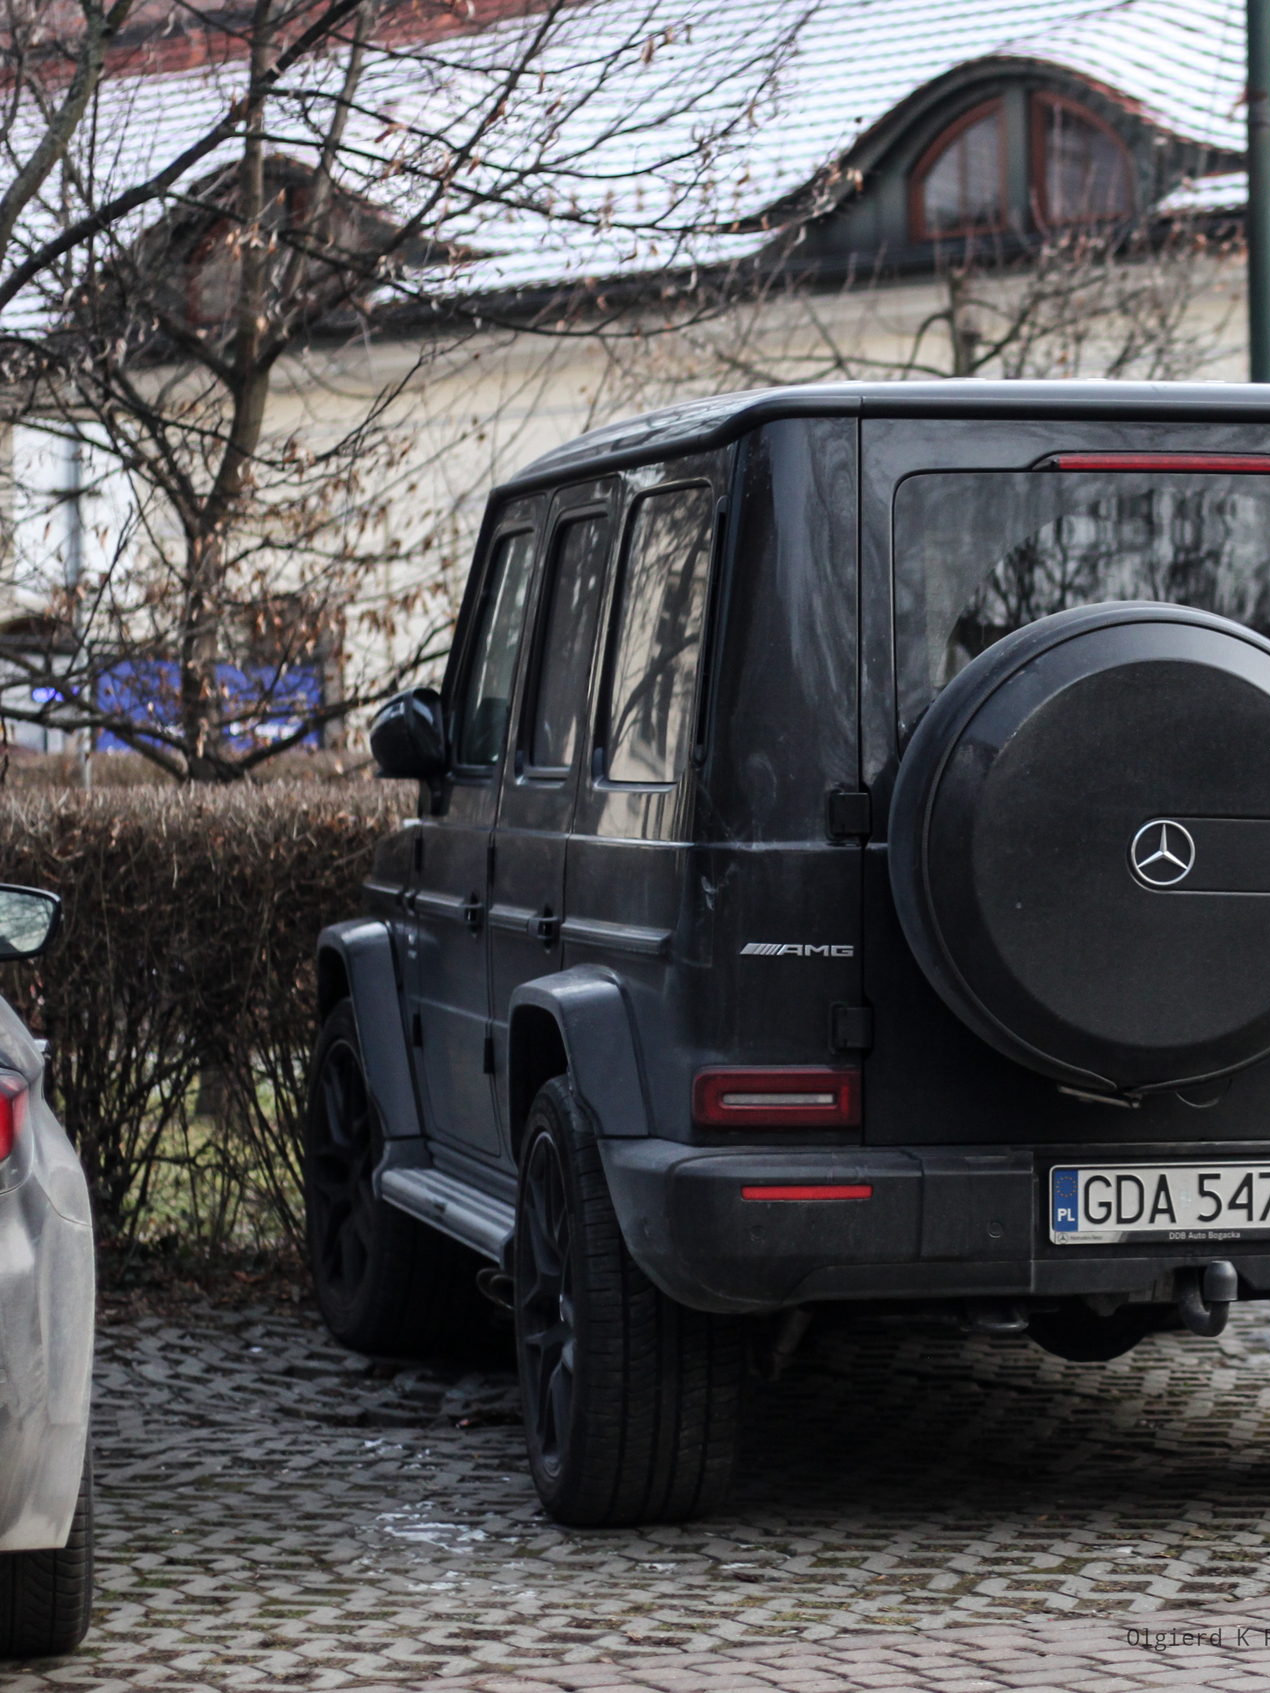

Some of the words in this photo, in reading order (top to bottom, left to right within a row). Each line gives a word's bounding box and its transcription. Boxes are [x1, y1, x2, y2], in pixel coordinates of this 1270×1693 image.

[1083, 1173, 1177, 1225] GDA
[1057, 1208, 1076, 1222] PL
[1188, 1231, 1207, 1240] Auto
